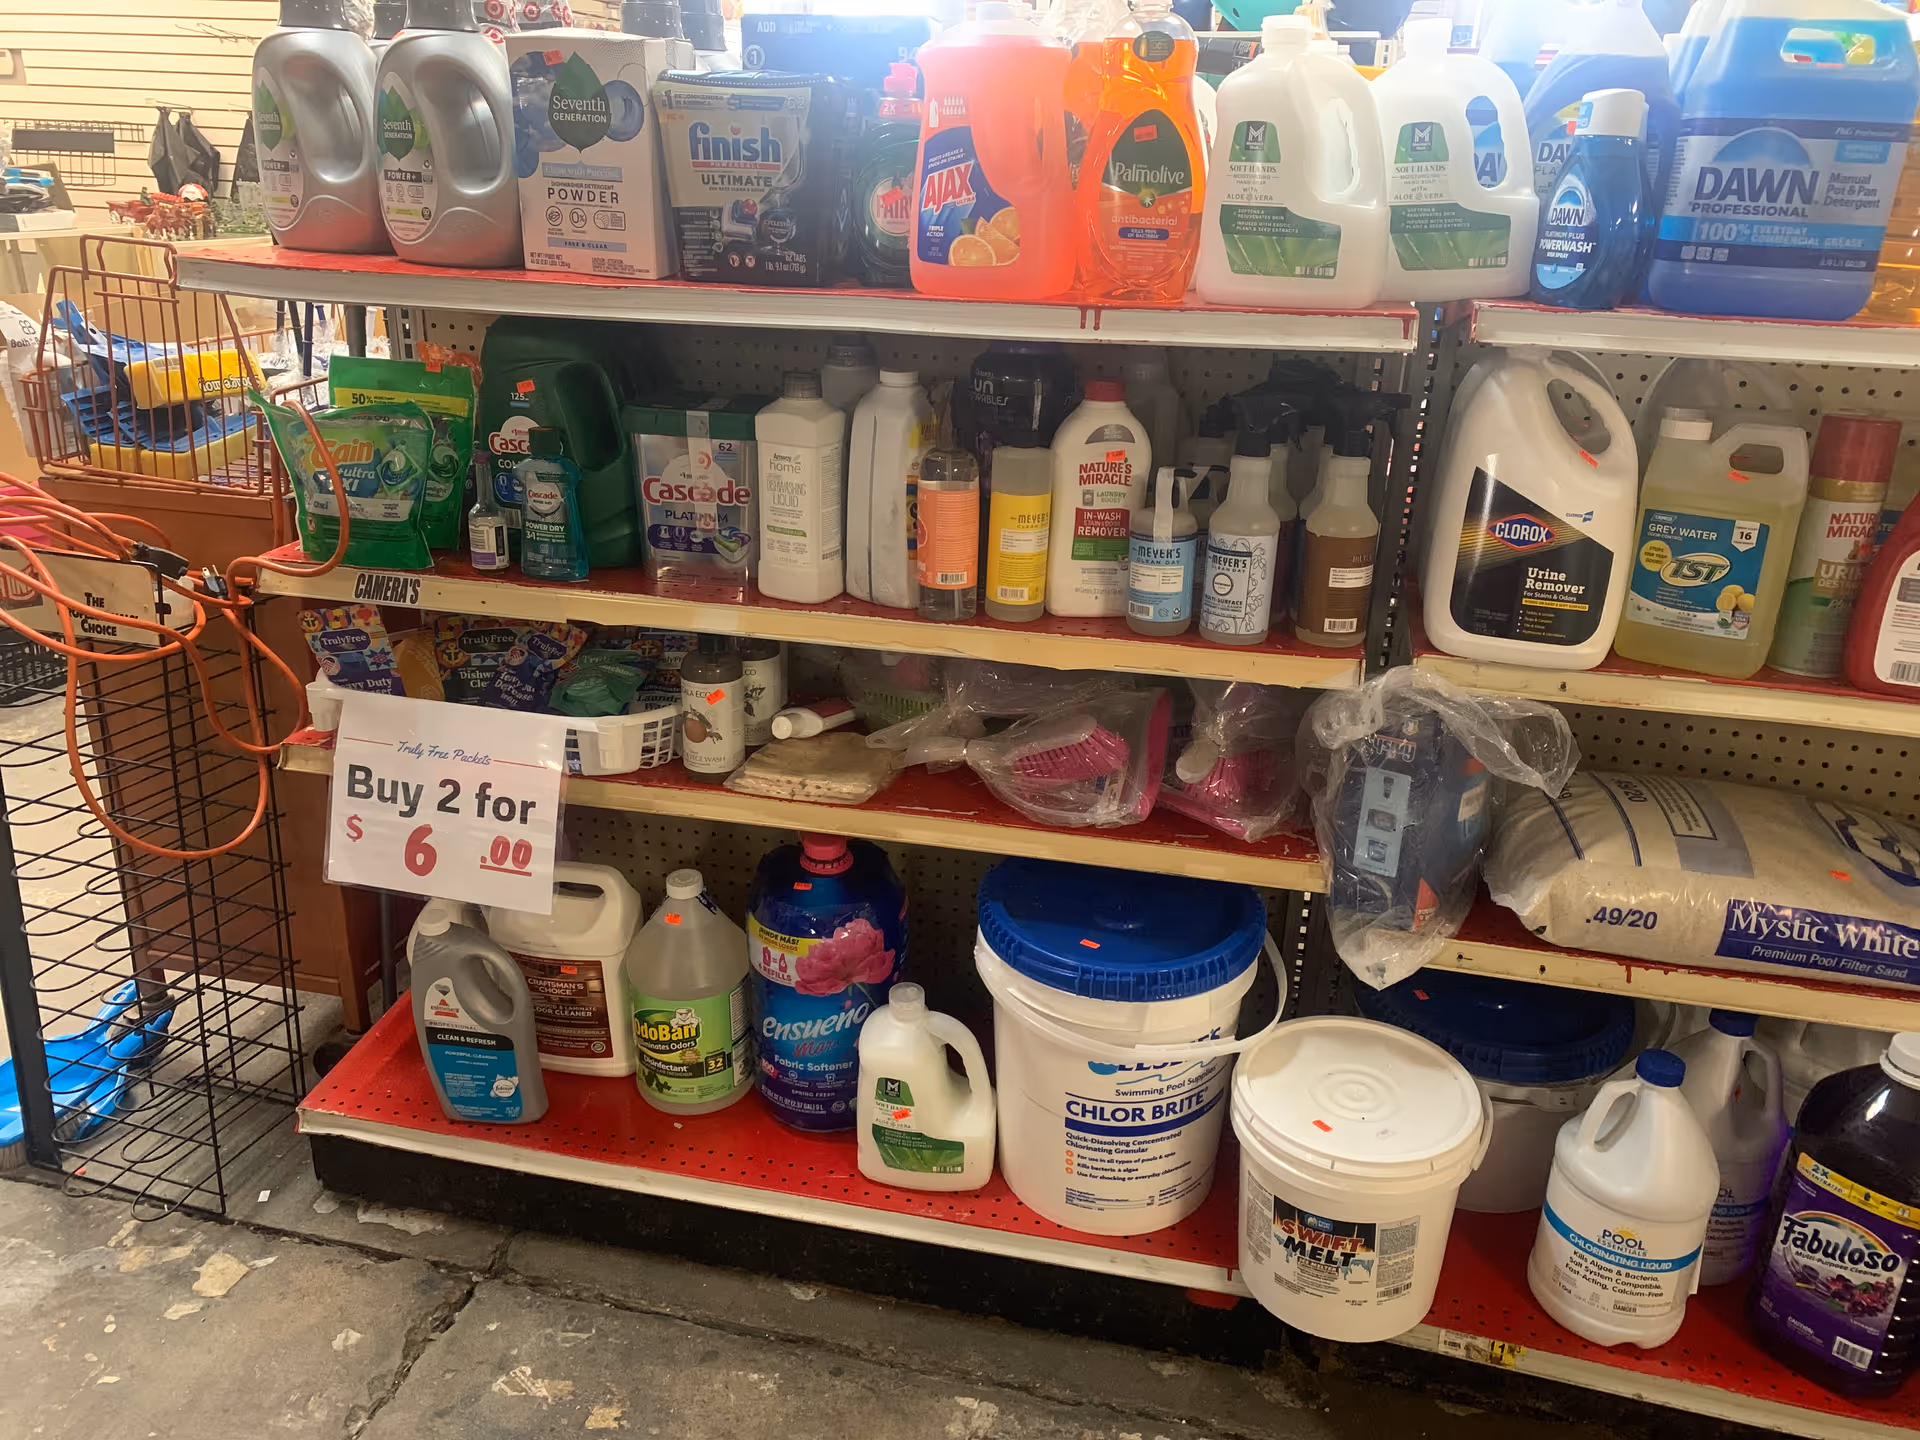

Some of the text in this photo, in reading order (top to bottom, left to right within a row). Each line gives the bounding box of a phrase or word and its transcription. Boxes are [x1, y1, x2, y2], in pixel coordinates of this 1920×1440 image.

[757, 22, 776, 33] ADD
[552, 96, 606, 113] Seventh
[883, 104, 896, 112] 2X
[383, 119, 412, 131] Seventh
[552, 112, 607, 124] GENERATION
[688, 121, 782, 163] finish
[1114, 162, 1184, 185] Palmolive
[1229, 164, 1277, 173] SOFT HANDS
[701, 173, 773, 187] ULTIMATE
[1694, 166, 1818, 205] DAWN
[1829, 172, 1873, 185] Manual
[547, 187, 620, 204] POWDER
[922, 161, 974, 215] AJAX
[1826, 184, 1878, 197] Pot & Pan
[1823, 195, 1881, 210] Detergent
[1550, 207, 1585, 225] DAWN
[1691, 203, 1809, 218] PROFESSIONAL
[1111, 213, 1178, 226] antibacterial
[1568, 231, 1585, 239] PLUS
[1700, 222, 1808, 242] 100% EVERYDAY
[1539, 238, 1593, 253] POWERWASH
[1751, 234, 1864, 248] COMMERCIAL GREASE
[351, 392, 374, 406] 50%
[510, 392, 526, 401] 125
[310, 439, 374, 469] Gain
[718, 442, 733, 452] 62
[773, 453, 792, 463] Amway
[769, 458, 802, 474] home
[1078, 461, 1133, 475] NATURE'S
[1078, 473, 1133, 487] MIRACLE
[527, 488, 559, 500] Cascade
[642, 477, 751, 505] Cascade
[766, 479, 807, 497] DISHWASHING
[772, 493, 799, 508] LIQUID
[1083, 511, 1121, 521] IN-WASH
[1829, 512, 1876, 525] NATUR
[525, 521, 565, 532] POWER DRY
[1077, 526, 1127, 537] REMOVER
[1495, 521, 1549, 543] CLOROX
[1648, 523, 1718, 541] GREY WATER
[1826, 525, 1875, 539] MIRAC
[1738, 531, 1752, 541] 16
[1137, 545, 1181, 559] MEYER'S
[1211, 554, 1247, 569] MEYER'S
[1527, 567, 1566, 582] Urine
[1669, 558, 1730, 583] TST
[352, 573, 421, 605] CAMERA'S
[1525, 578, 1585, 594] Remover
[84, 592, 105, 608] THE
[1523, 590, 1534, 598] For
[1534, 591, 1552, 600] Stains
[1558, 594, 1577, 602] Odors
[80, 619, 118, 637] CHOICE
[321, 634, 367, 646] TrulyFree
[461, 633, 515, 645] TrulyFree
[366, 677, 393, 689] Duty
[397, 741, 492, 766] Truly Free Packets
[347, 763, 536, 825] Buy 2 for
[346, 813, 533, 877] $ 6 .00
[1585, 906, 1658, 931] .49/20
[780, 934, 800, 946] MÁS!
[1728, 906, 1920, 960] Mystic White
[1751, 945, 1909, 980] Premium Pool Filter Sand
[762, 966, 792, 982] REFILLS
[527, 978, 585, 990] CRAFTSMAN'S
[538, 986, 573, 996] CHOICE
[554, 1009, 593, 1017] CLEANER
[428, 1021, 477, 1031] PROFESSIONAL
[634, 1017, 697, 1041] OdoBan
[436, 1033, 460, 1042] CLEAN
[466, 1037, 497, 1046] REFRESH
[670, 1040, 696, 1050] Odors
[643, 1054, 689, 1072] Disinfectant
[707, 1057, 724, 1070] 32
[774, 1054, 854, 1072] Fabric Softener
[1115, 1064, 1218, 1097] Swimming Pool Supplies
[791, 1089, 814, 1098] SPRING
[1065, 1089, 1206, 1123] CHLOR BRITE
[1065, 1130, 1182, 1147] Quick-Dissolving Concentrated
[1065, 1140, 1113, 1155] Chlorinating
[1141, 1155, 1158, 1164] pools
[1076, 1162, 1090, 1170] Kills
[1090, 1165, 1116, 1173] bacteria
[1099, 1174, 1127, 1182] shocking
[1134, 1172, 1161, 1181] everyday
[1161, 1160, 1192, 1176] chlorination
[1811, 1164, 1830, 1180] 2X
[1281, 1218, 1365, 1253] SWIFT
[1601, 1228, 1645, 1251] POOL
[1283, 1235, 1356, 1267] MELT
[1569, 1233, 1673, 1270] CHLORINATING LIQUID
[1597, 1238, 1648, 1257] ESSENTIALS
[1780, 1215, 1902, 1273] Fabuloso
[1299, 1257, 1338, 1273] ICE MELTER
[1569, 1256, 1583, 1268] Salt
[1584, 1264, 1613, 1282] System
[1573, 1249, 1589, 1263] Kills
[1589, 1260, 1614, 1274] Algae
[1615, 1269, 1623, 1277] &
[1794, 1250, 1882, 1278] Multi-Purpose Cleaner
[1611, 1285, 1664, 1298] Calcium-Free
[1612, 1303, 1638, 1313] DANGER
